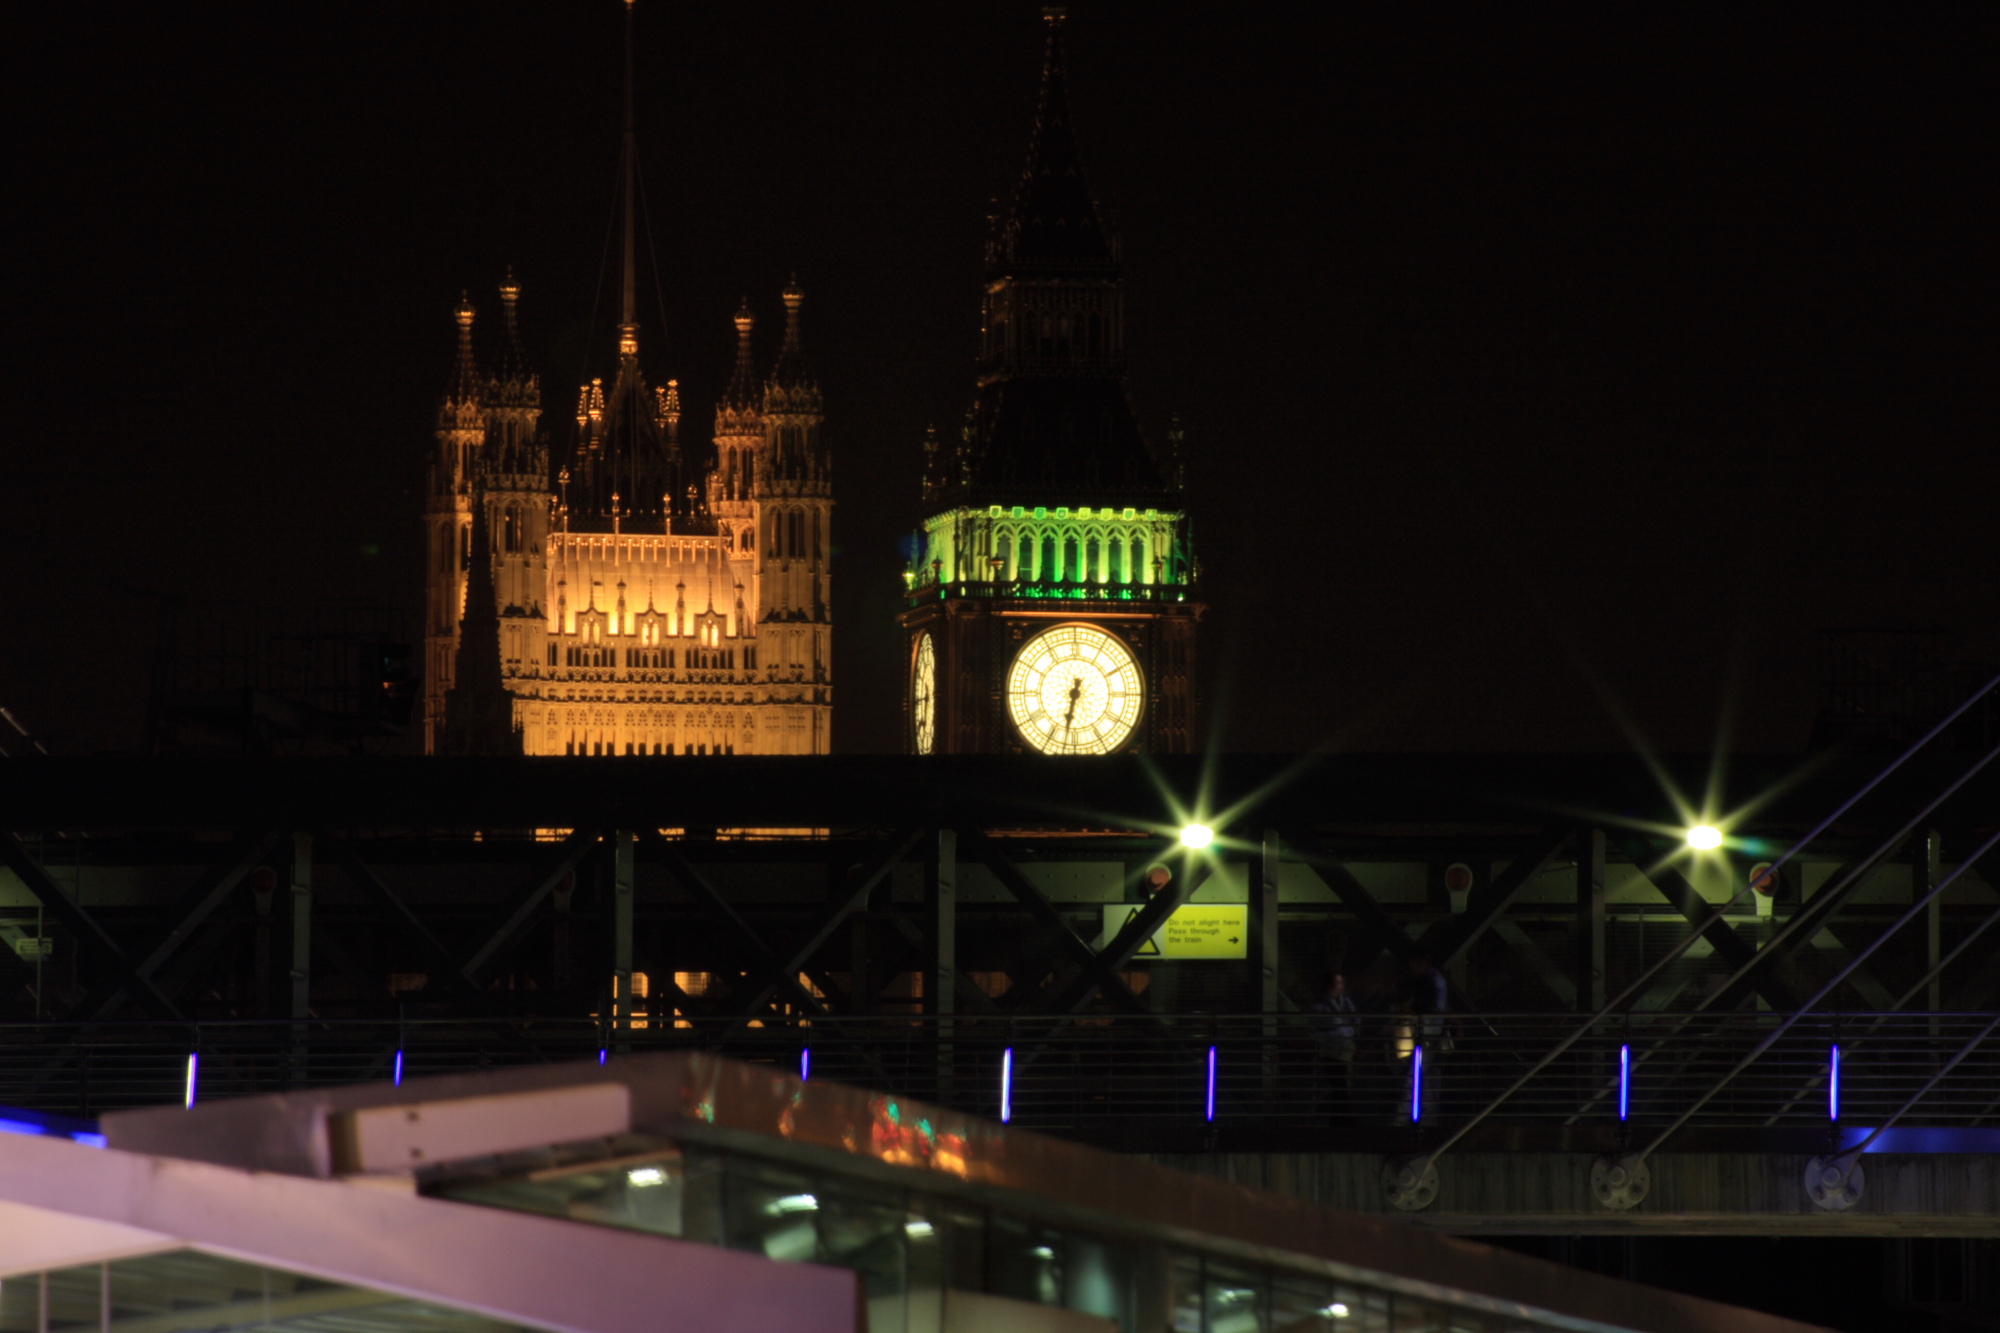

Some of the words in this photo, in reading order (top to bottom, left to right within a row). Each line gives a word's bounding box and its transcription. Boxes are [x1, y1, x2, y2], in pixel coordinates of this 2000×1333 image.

[1168, 918, 1180, 926] Do
[1198, 918, 1220, 927] alight
[1190, 927, 1220, 936] through
